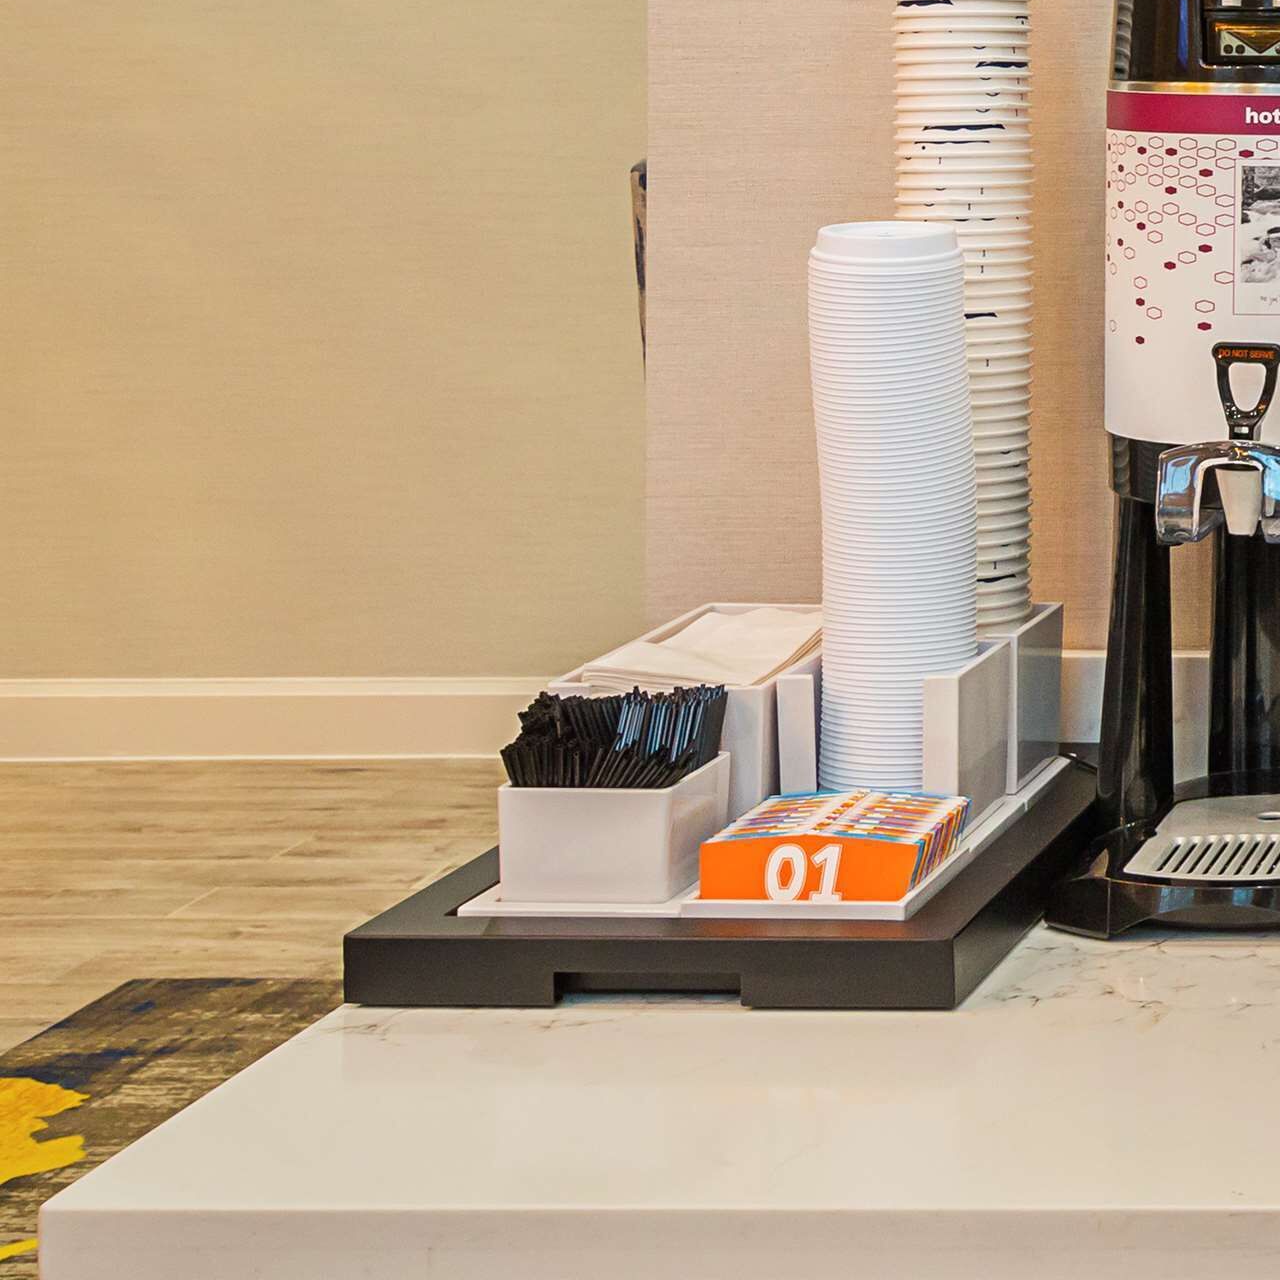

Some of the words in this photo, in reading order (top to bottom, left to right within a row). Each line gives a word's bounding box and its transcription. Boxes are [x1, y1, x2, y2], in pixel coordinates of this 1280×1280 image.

[1232, 349, 1248, 359] NOT
[1249, 350, 1275, 359] SERVE
[764, 843, 843, 901] 01
